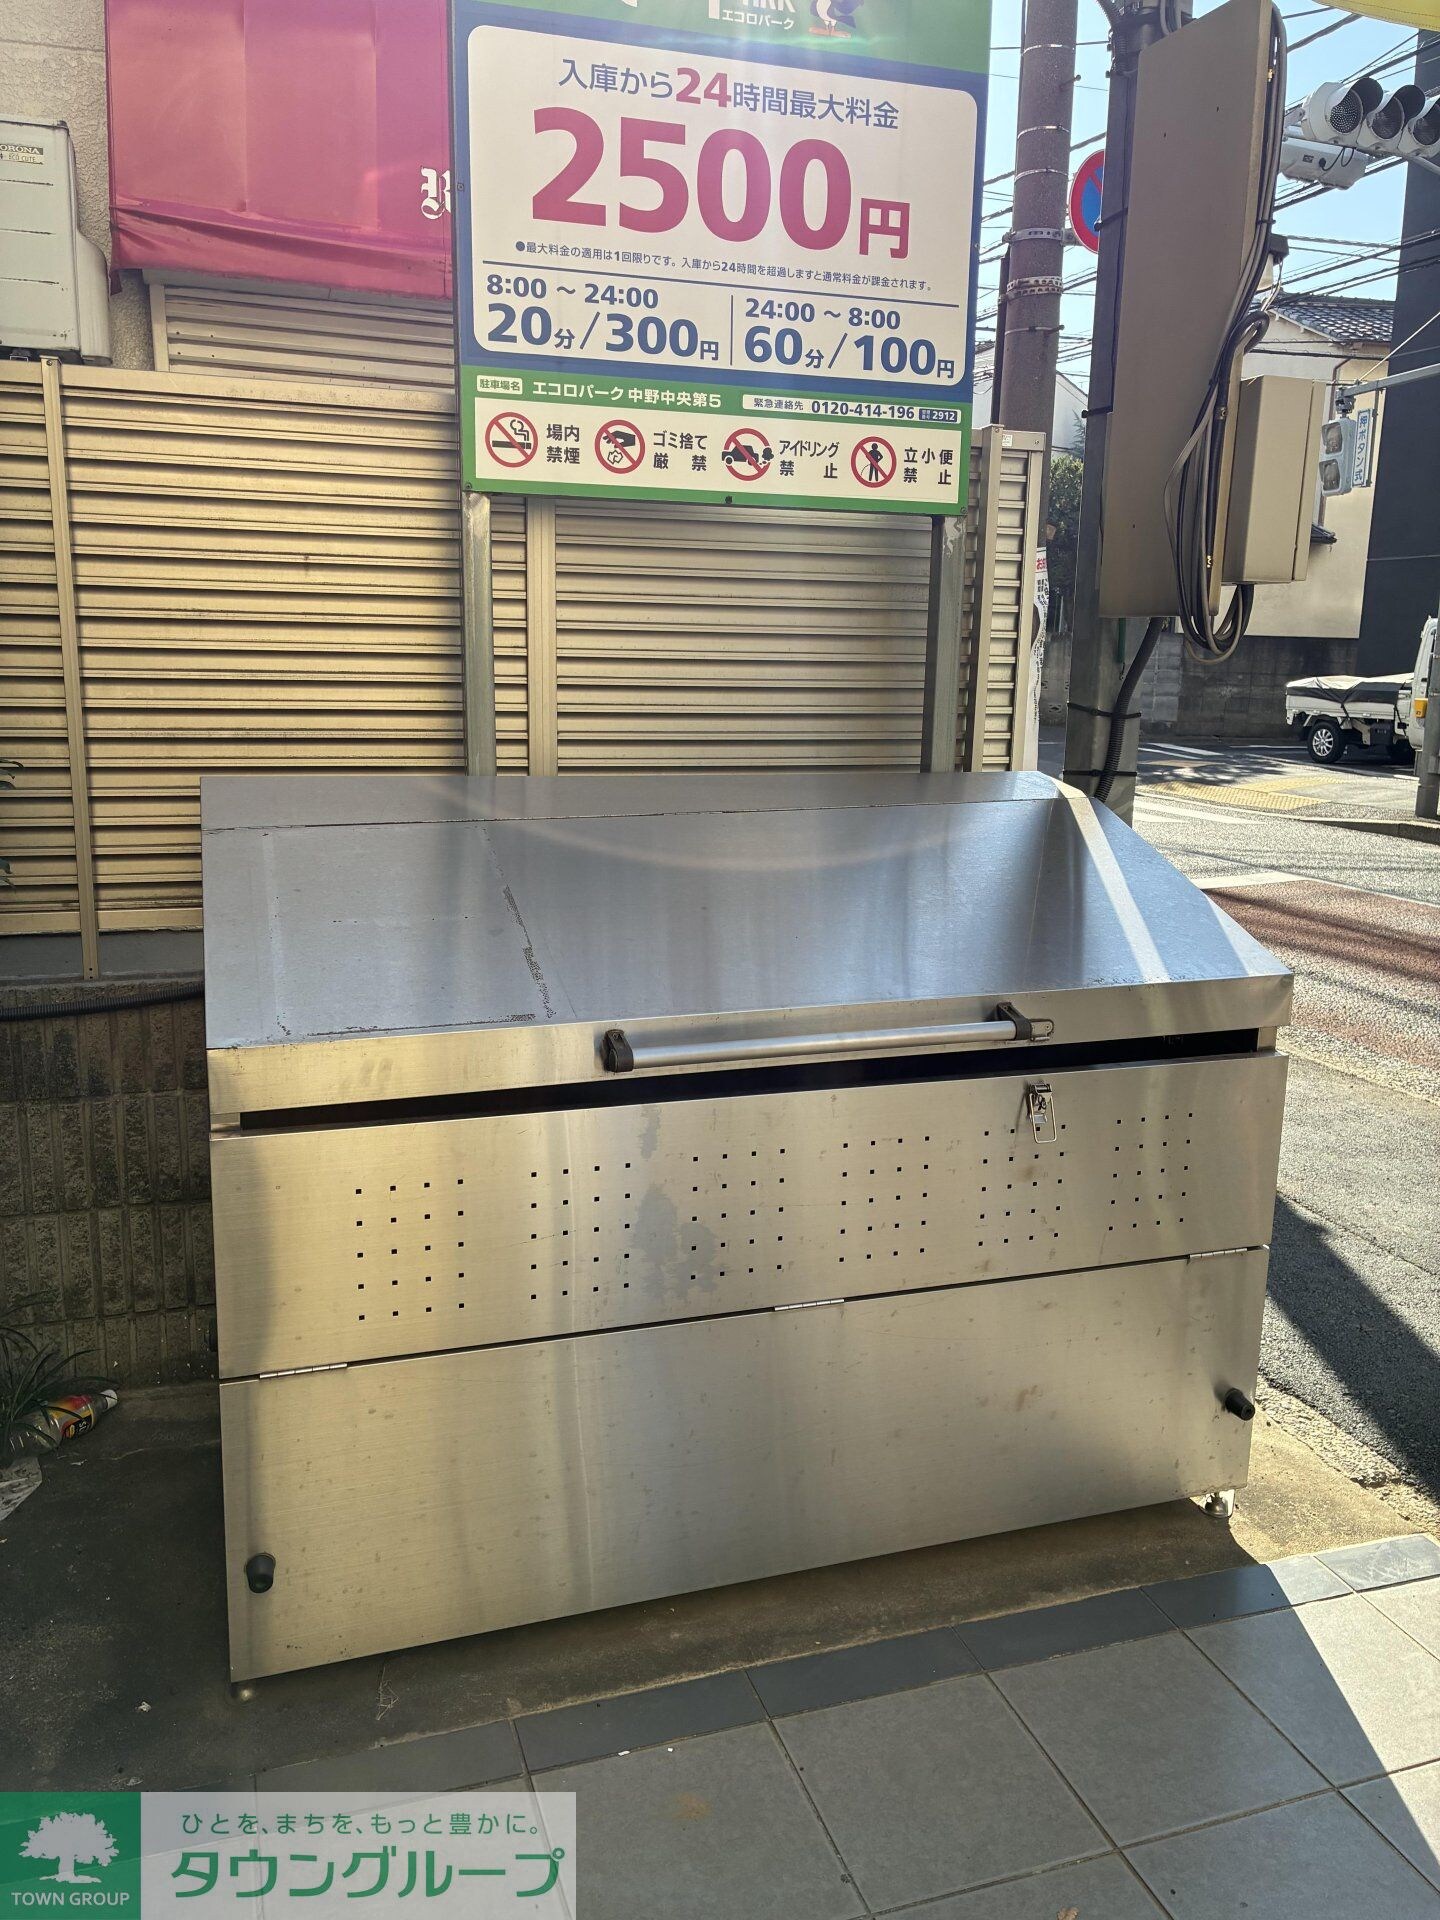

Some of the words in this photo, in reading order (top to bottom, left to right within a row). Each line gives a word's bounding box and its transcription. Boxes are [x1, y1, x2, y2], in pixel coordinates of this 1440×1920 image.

[722, 9, 795, 30] エコロパーク
[558, 58, 899, 129] 入庫から24時間最大料金
[532, 106, 911, 260] 2500円
[486, 274, 547, 299] 8:00
[584, 283, 659, 309] 24:00
[745, 298, 816, 323] 24:00
[848, 307, 901, 330] 8:00
[479, 378, 521, 392] 駐車場名
[532, 381, 624, 401] エコロパーク
[628, 387, 722, 408] 中野中央第5
[753, 397, 804, 411] 緊急連絡先
[811, 400, 915, 419] 0120-414-196
[932, 410, 956, 421] 2912
[546, 423, 580, 442] 場内
[653, 430, 708, 450] ゴミ捨て
[546, 446, 580, 465] 禁煙
[779, 439, 840, 458] アイドリング
[904, 446, 954, 465] 立小便
